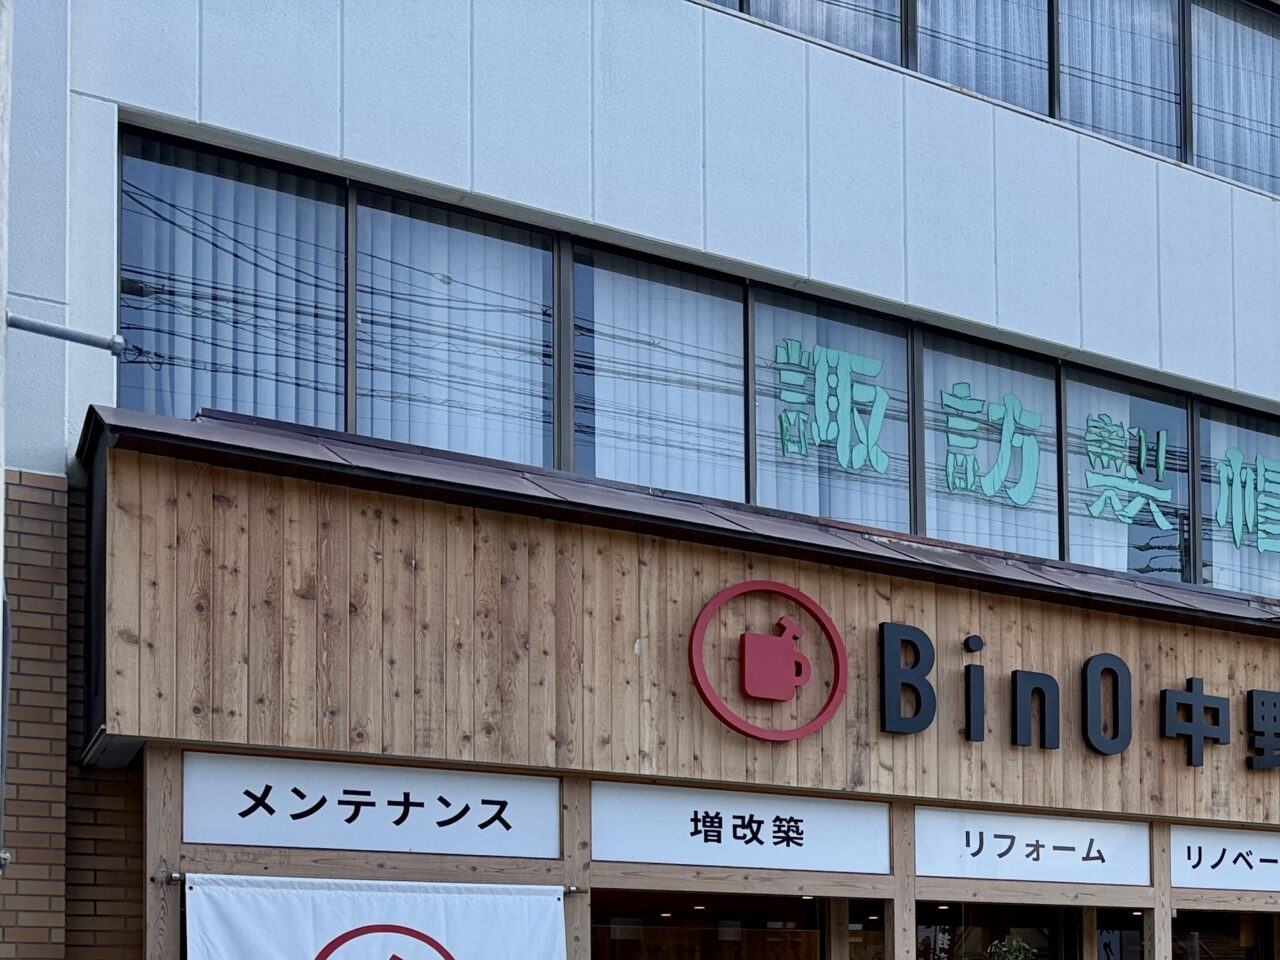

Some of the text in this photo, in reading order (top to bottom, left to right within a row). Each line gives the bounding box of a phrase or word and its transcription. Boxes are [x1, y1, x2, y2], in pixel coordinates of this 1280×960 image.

[237, 784, 512, 832] メンテナンス
[689, 810, 805, 848] 増改築
[964, 830, 1106, 864] リフォーム
